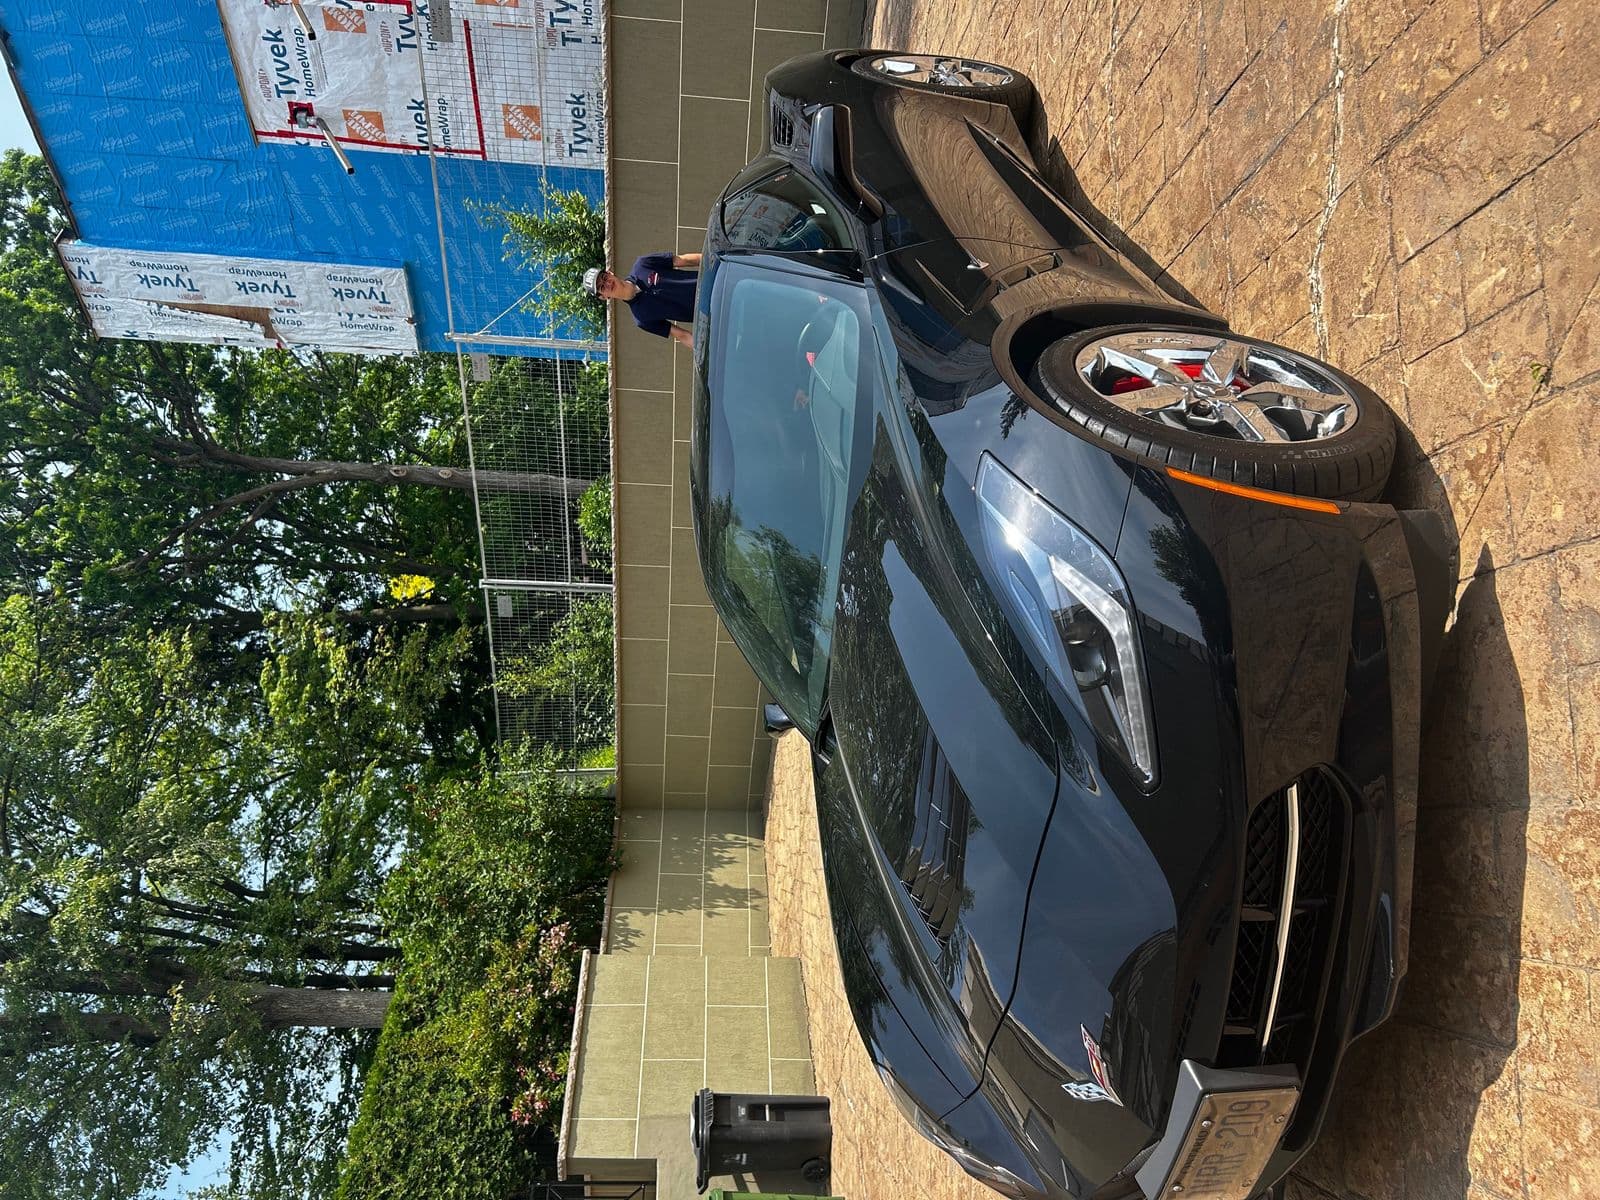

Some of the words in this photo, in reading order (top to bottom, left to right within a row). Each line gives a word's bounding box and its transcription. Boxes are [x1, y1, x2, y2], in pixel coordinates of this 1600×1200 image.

[262, 28, 300, 98] Tyvek
[293, 28, 317, 97] HomeWrap
[258, 71, 272, 99] DUPONT
[565, 93, 594, 157] Tyvek
[129, 259, 189, 273] HomeWrap
[228, 267, 287, 279] HomeWrap
[136, 273, 200, 292] Tyvek
[235, 280, 296, 298] Tyvek
[326, 274, 383, 285] HomeWrap
[331, 286, 391, 304] Tyvek
[1214, 1100, 1271, 1140] 209
